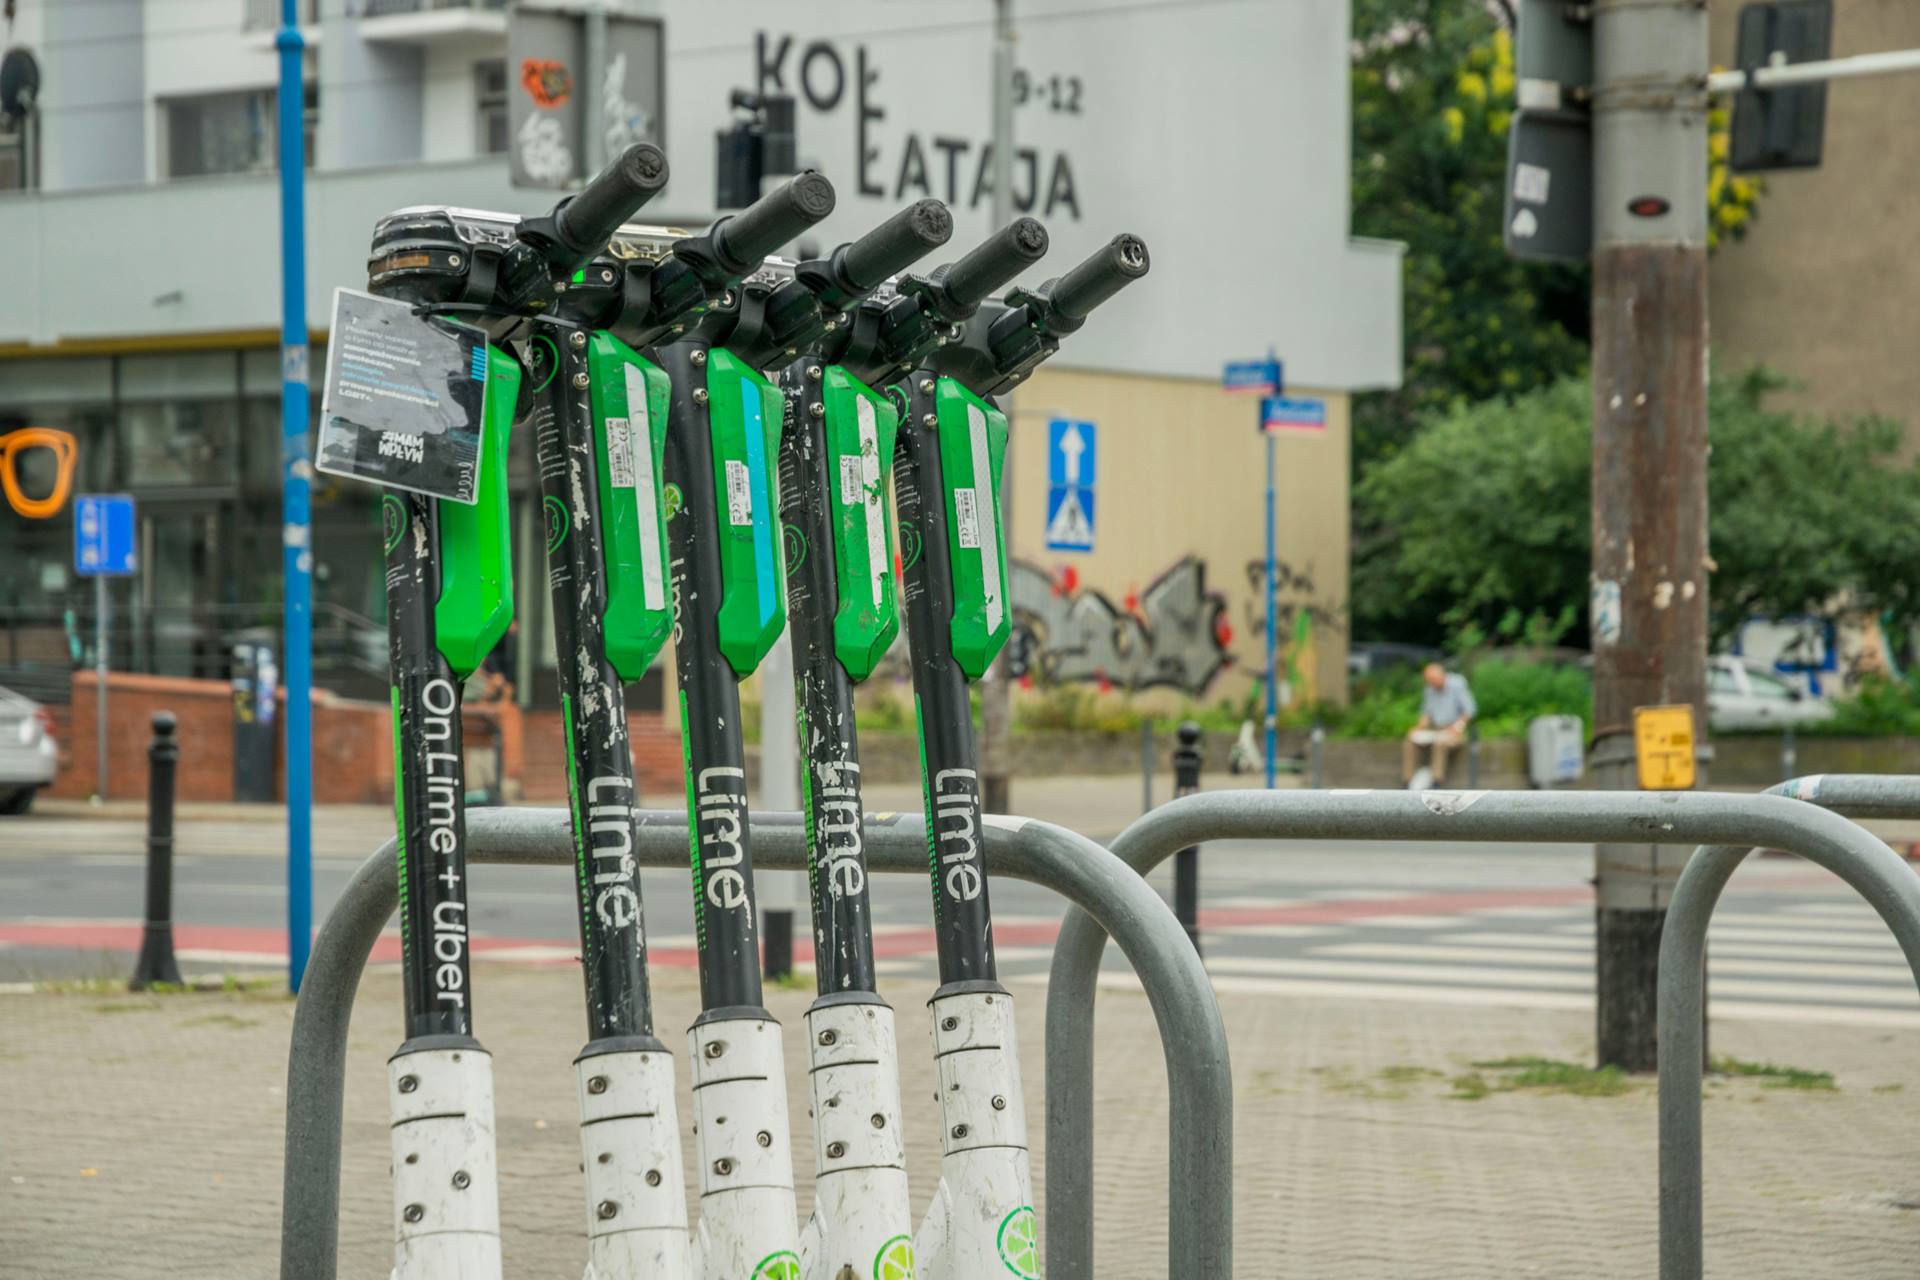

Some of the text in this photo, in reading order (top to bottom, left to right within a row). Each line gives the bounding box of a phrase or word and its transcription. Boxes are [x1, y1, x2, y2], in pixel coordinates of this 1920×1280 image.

[421, 678, 466, 1007] On Lime + Uber
[587, 776, 640, 927] Lime
[699, 766, 747, 908] Lime
[817, 761, 865, 897] Lime
[935, 768, 981, 901] Lime
